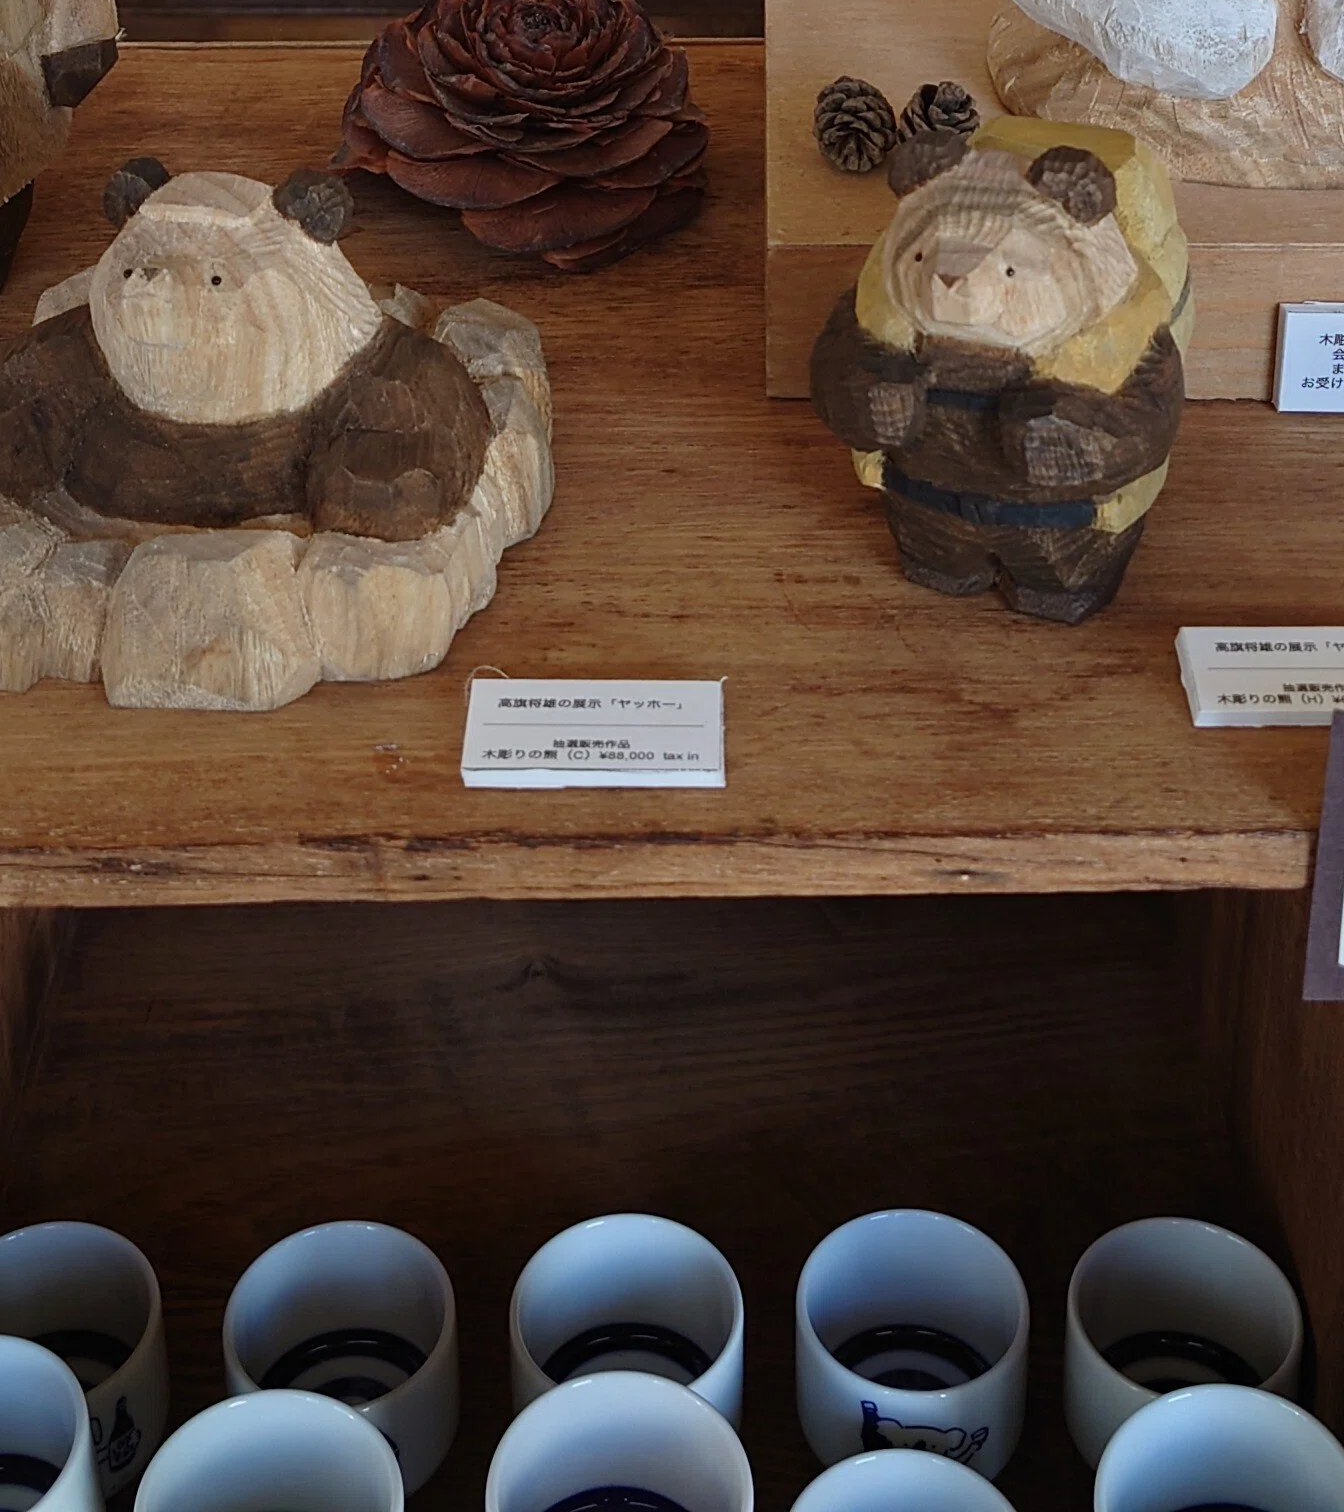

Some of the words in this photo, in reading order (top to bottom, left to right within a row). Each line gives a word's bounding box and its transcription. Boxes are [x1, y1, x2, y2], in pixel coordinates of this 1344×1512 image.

[497, 697, 684, 710] 高旗将雄の展示「ヤッホー」
[552, 739, 631, 748] 抽選販売作品
[663, 752, 684, 760] tax
[687, 751, 699, 760] in
